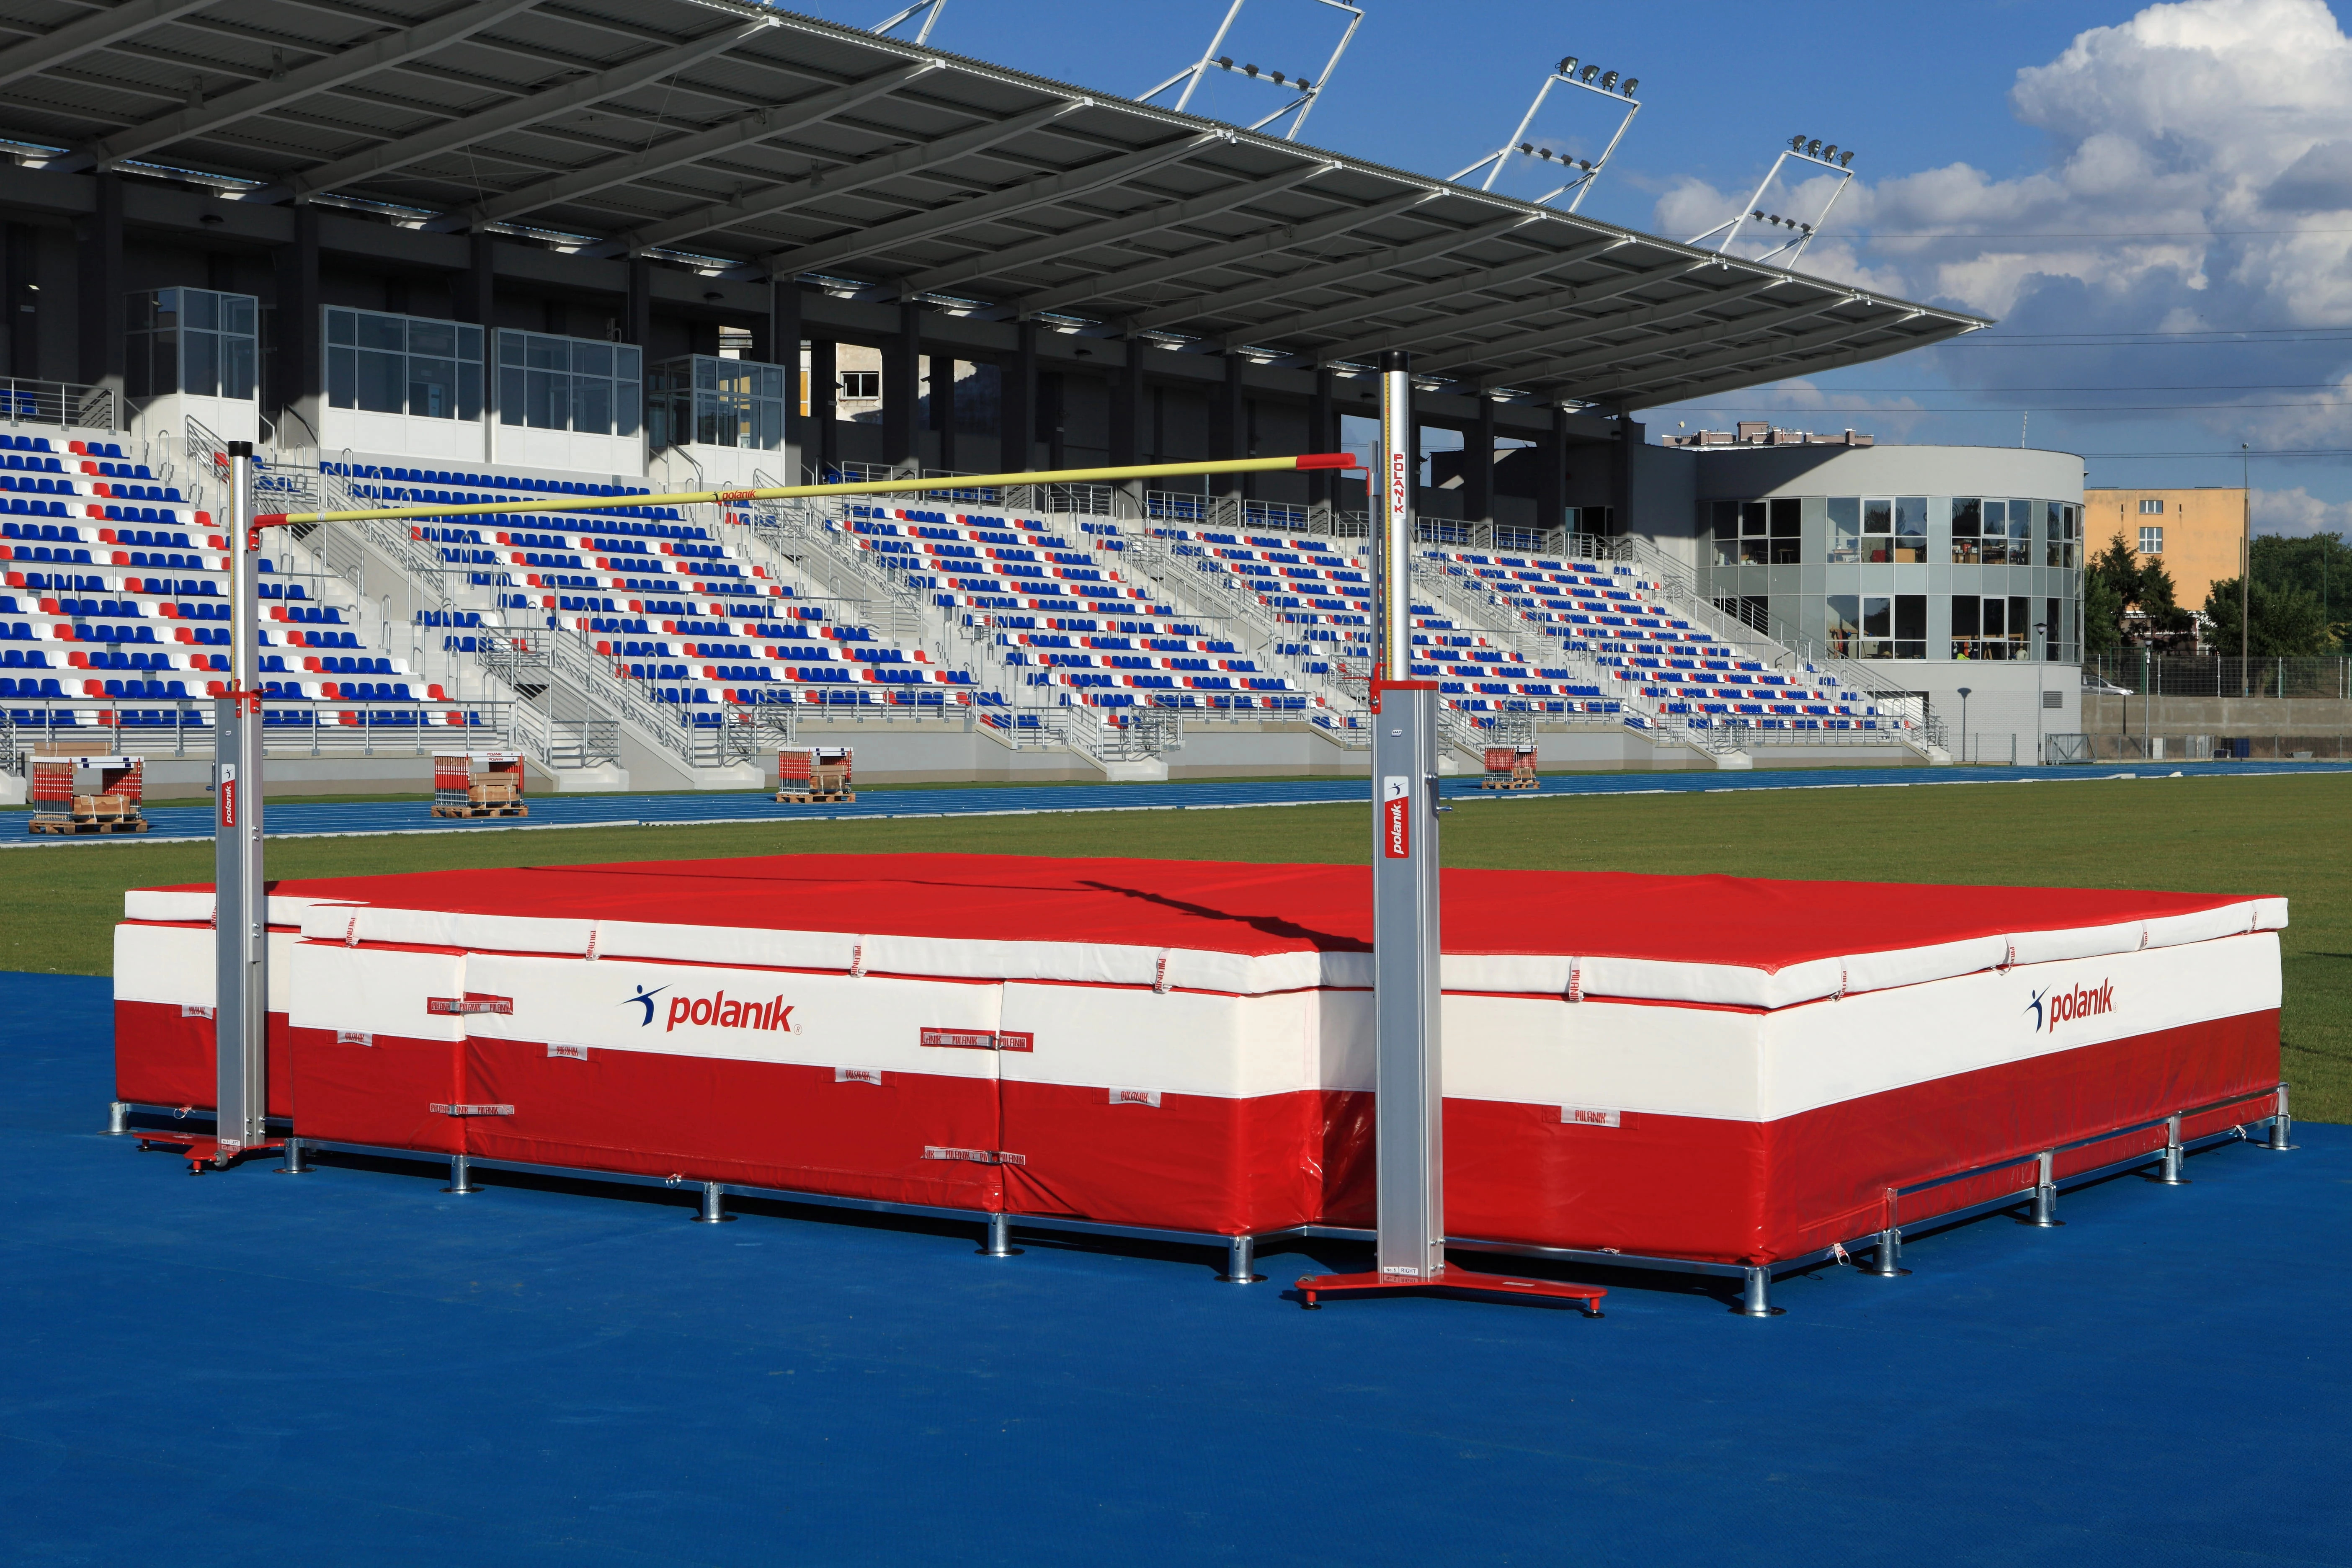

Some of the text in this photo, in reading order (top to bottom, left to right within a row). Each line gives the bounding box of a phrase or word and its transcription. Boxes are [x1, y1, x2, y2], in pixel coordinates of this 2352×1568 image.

[722, 490, 756, 500] polanik
[1393, 454, 1404, 513] POLANIK
[1391, 803, 1404, 855] polanik
[586, 931, 596, 958] POLANIK
[851, 946, 861, 975] POLANIK
[1155, 959, 1166, 990] POLANIK
[459, 1003, 481, 1011] POLANIK
[666, 990, 795, 1032] polanik
[2049, 977, 2114, 1034] polanik
[952, 1036, 977, 1045] POLANIK
[1000, 1037, 1025, 1047] POLANIK
[1121, 1091, 1148, 1104] POLANIK
[1575, 1110, 1606, 1124] POLANIK
[946, 1150, 970, 1159] POLANIK
